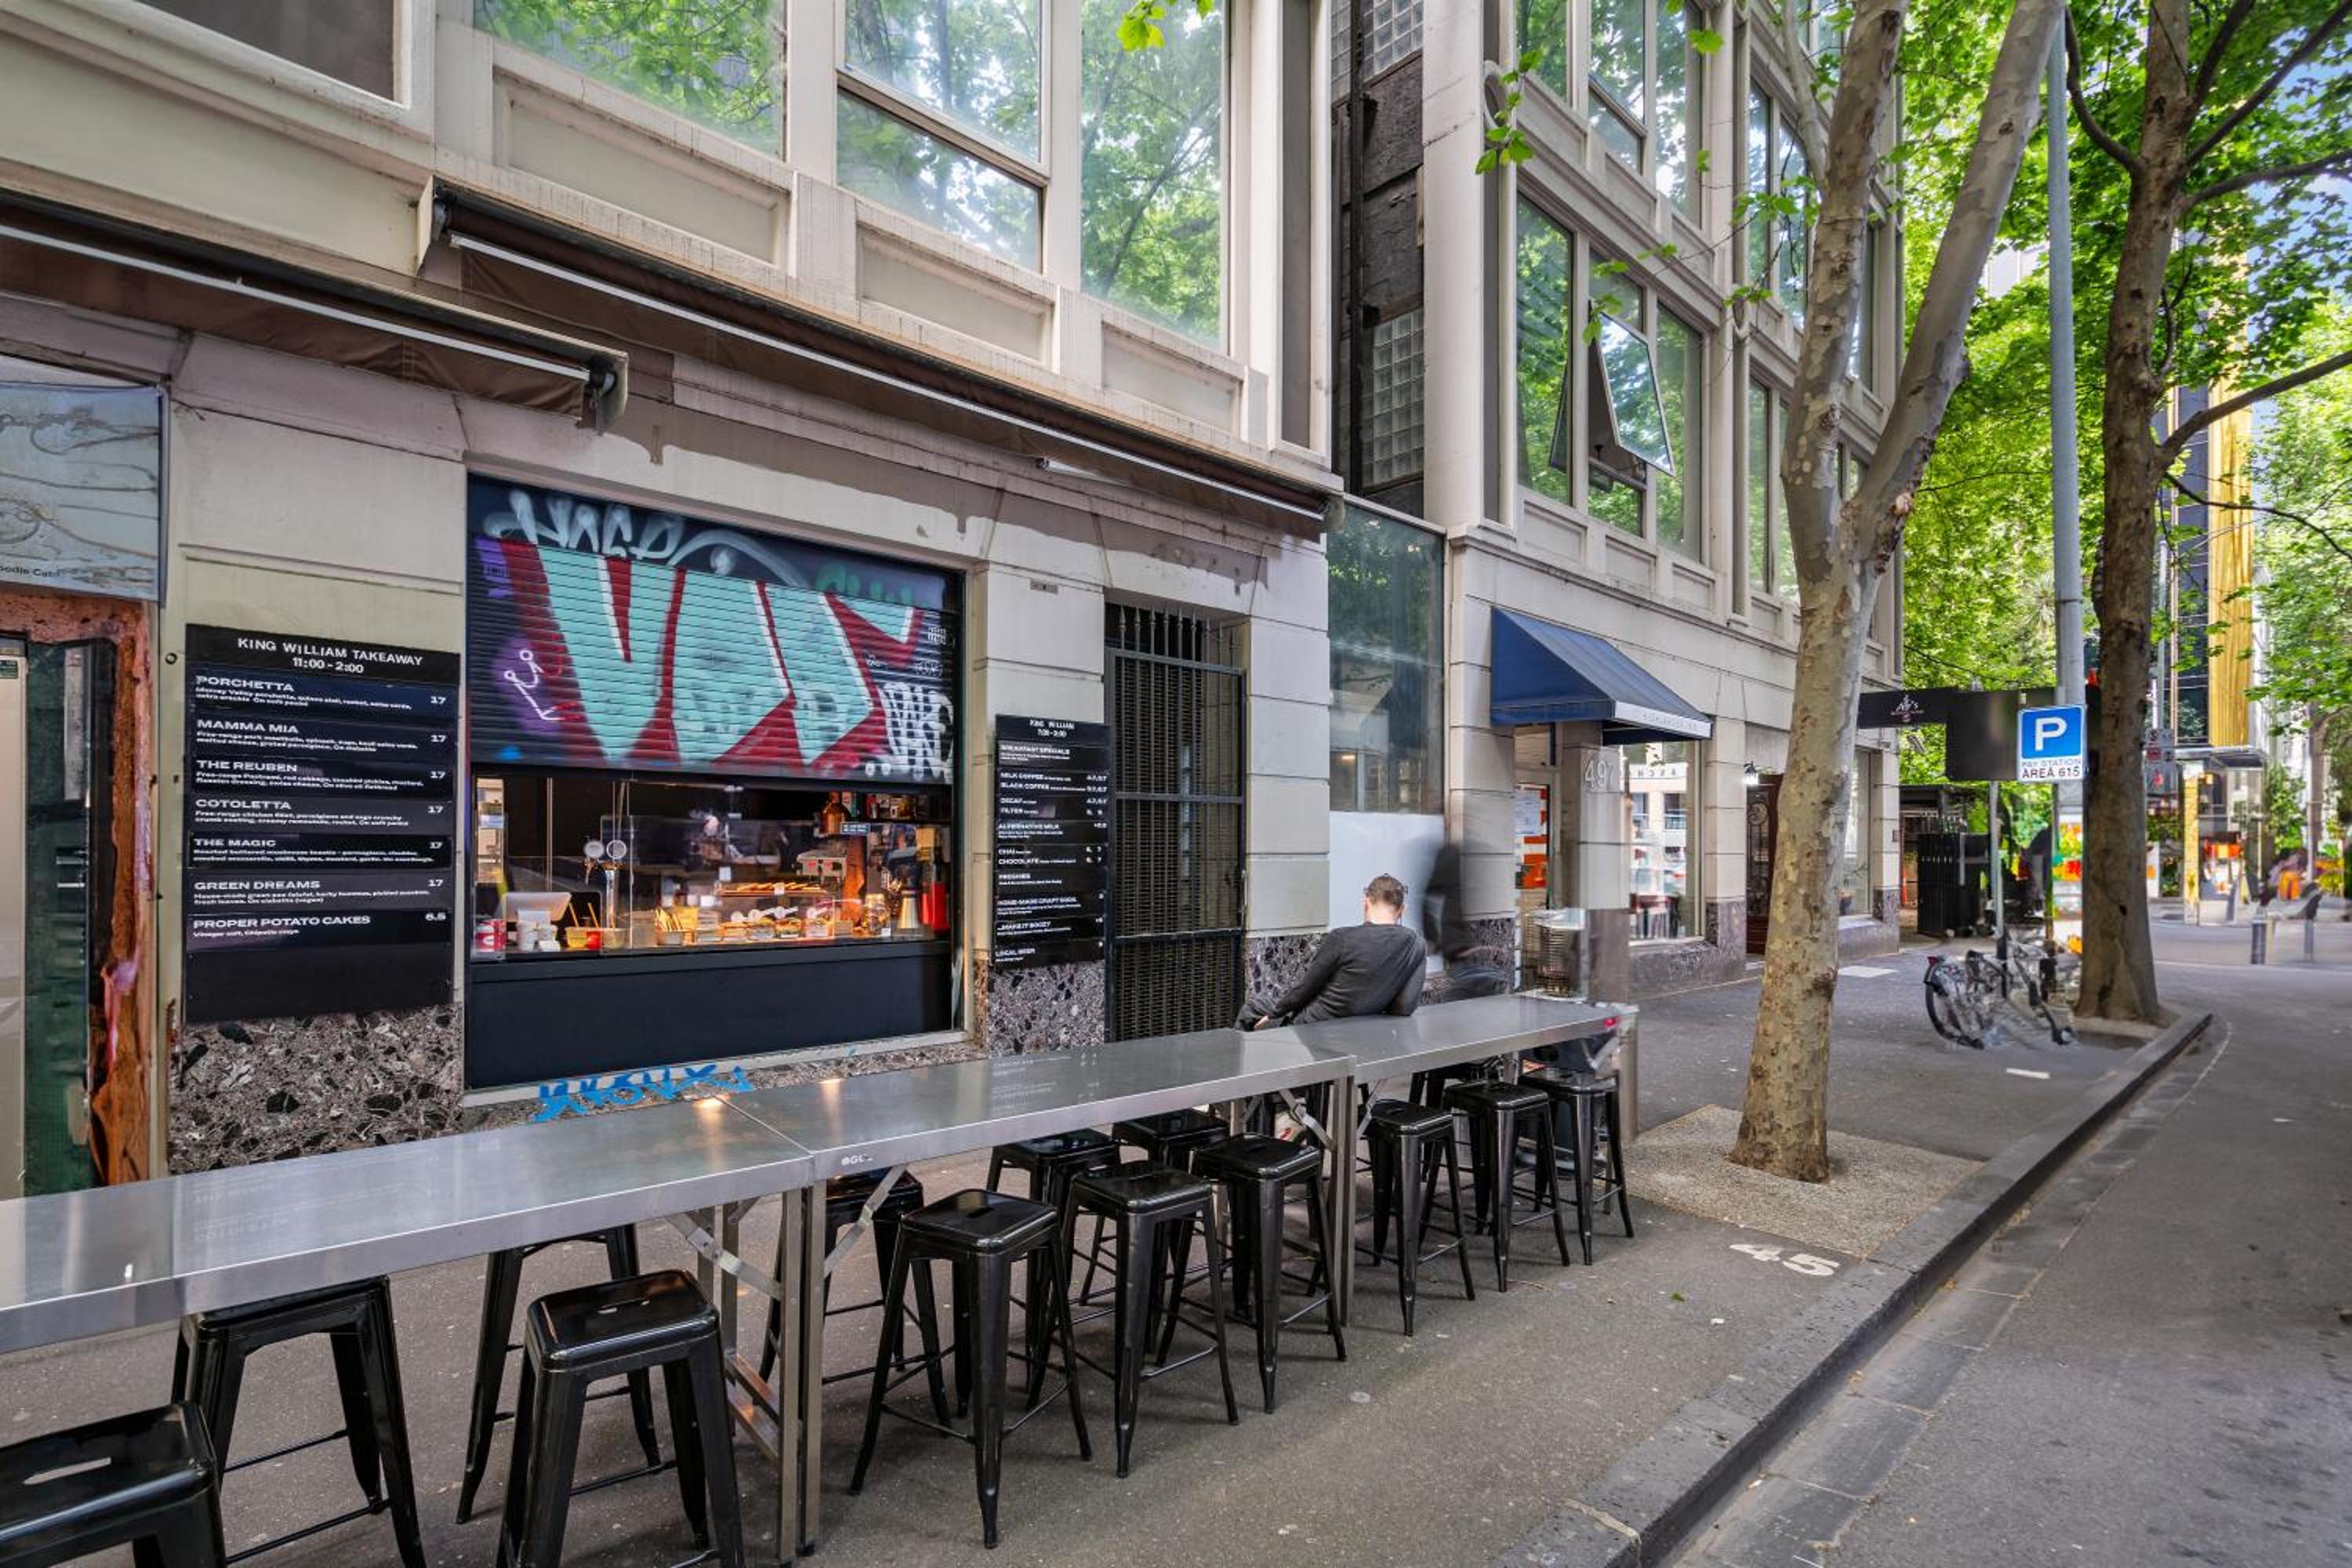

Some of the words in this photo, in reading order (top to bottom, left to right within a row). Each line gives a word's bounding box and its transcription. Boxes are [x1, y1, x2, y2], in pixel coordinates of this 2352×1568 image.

[238, 637, 276, 651] KING
[283, 642, 347, 658] WILLIAM
[353, 650, 423, 665] TAKEAWAY
[292, 657, 325, 669] 11:00
[195, 675, 294, 691] PORCHETTA
[197, 719, 266, 732] MAMMA
[269, 724, 299, 734] MIA
[2034, 717, 2067, 752] P
[197, 760, 230, 769] THE
[233, 761, 297, 772] REUBEN
[2041, 758, 2082, 767] STATION
[2022, 768, 2055, 779] AREA
[2058, 766, 2081, 777] 615
[195, 799, 292, 810] COTOLETTA
[194, 838, 224, 847] THE
[194, 882, 250, 891] GREEN
[253, 880, 321, 890] DREAMS
[194, 919, 257, 929] PROPER
[260, 917, 320, 927] POTATO
[322, 916, 371, 925] CAKES
[1730, 1243, 1841, 1276] 45
